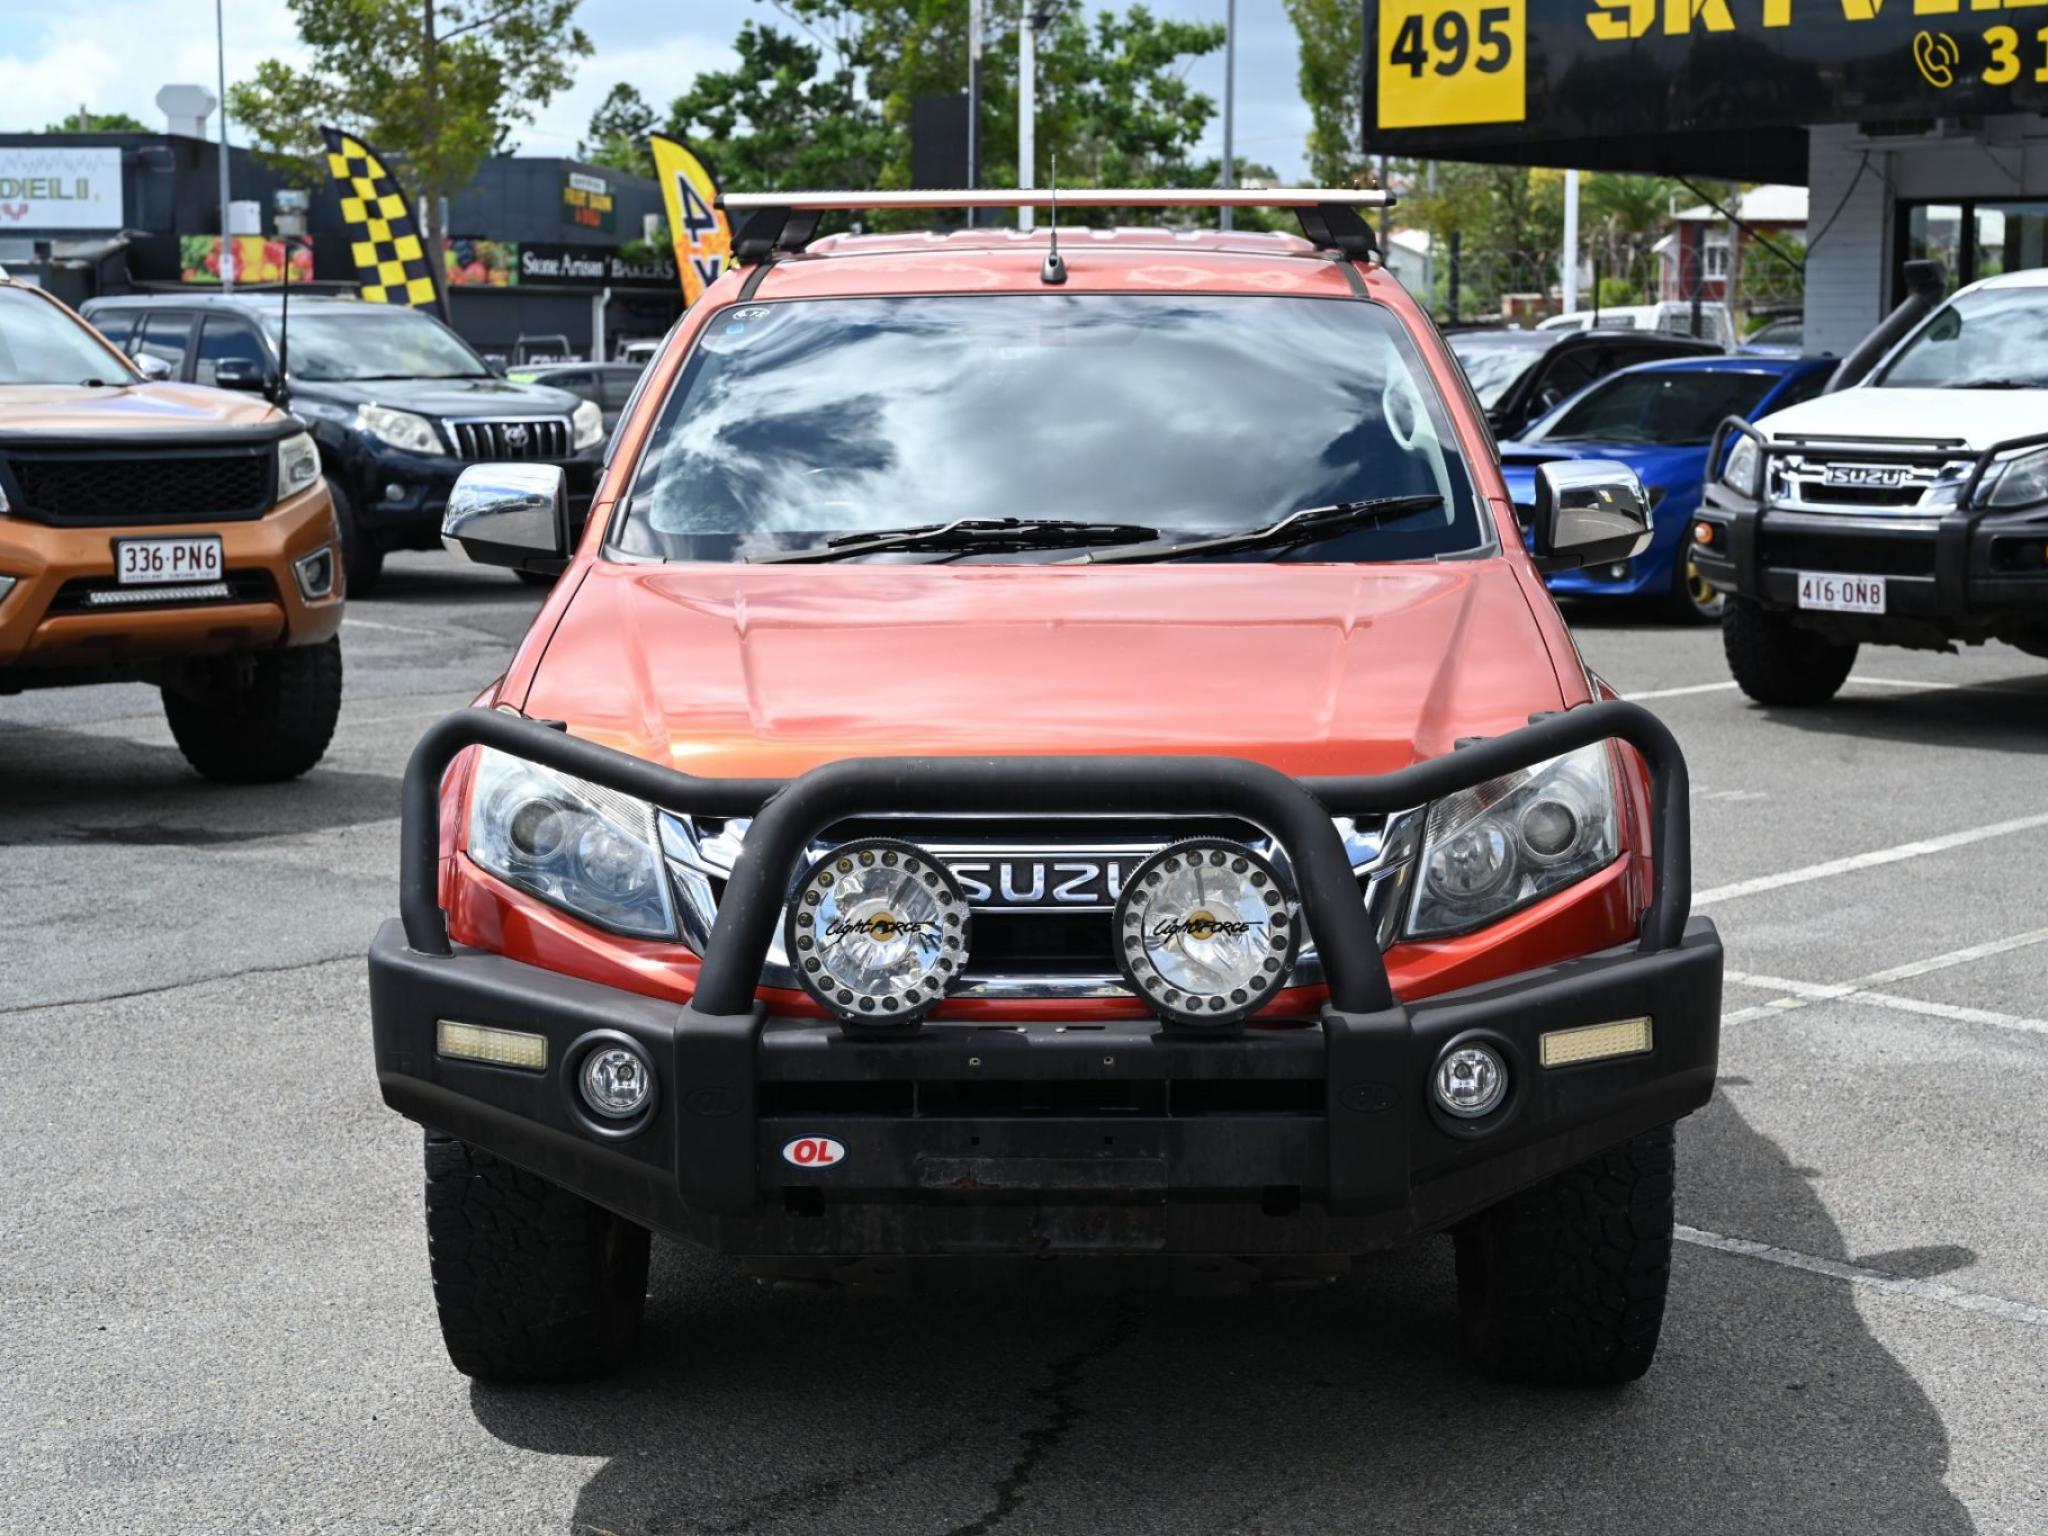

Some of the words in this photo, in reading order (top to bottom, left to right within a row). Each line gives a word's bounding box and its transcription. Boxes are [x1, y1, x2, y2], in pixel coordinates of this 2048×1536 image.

[1390, 7, 1512, 78] 495
[1827, 469, 1899, 486] ISUZU
[949, 862, 1122, 901] SUZ
[793, 1139, 834, 1163] OL
